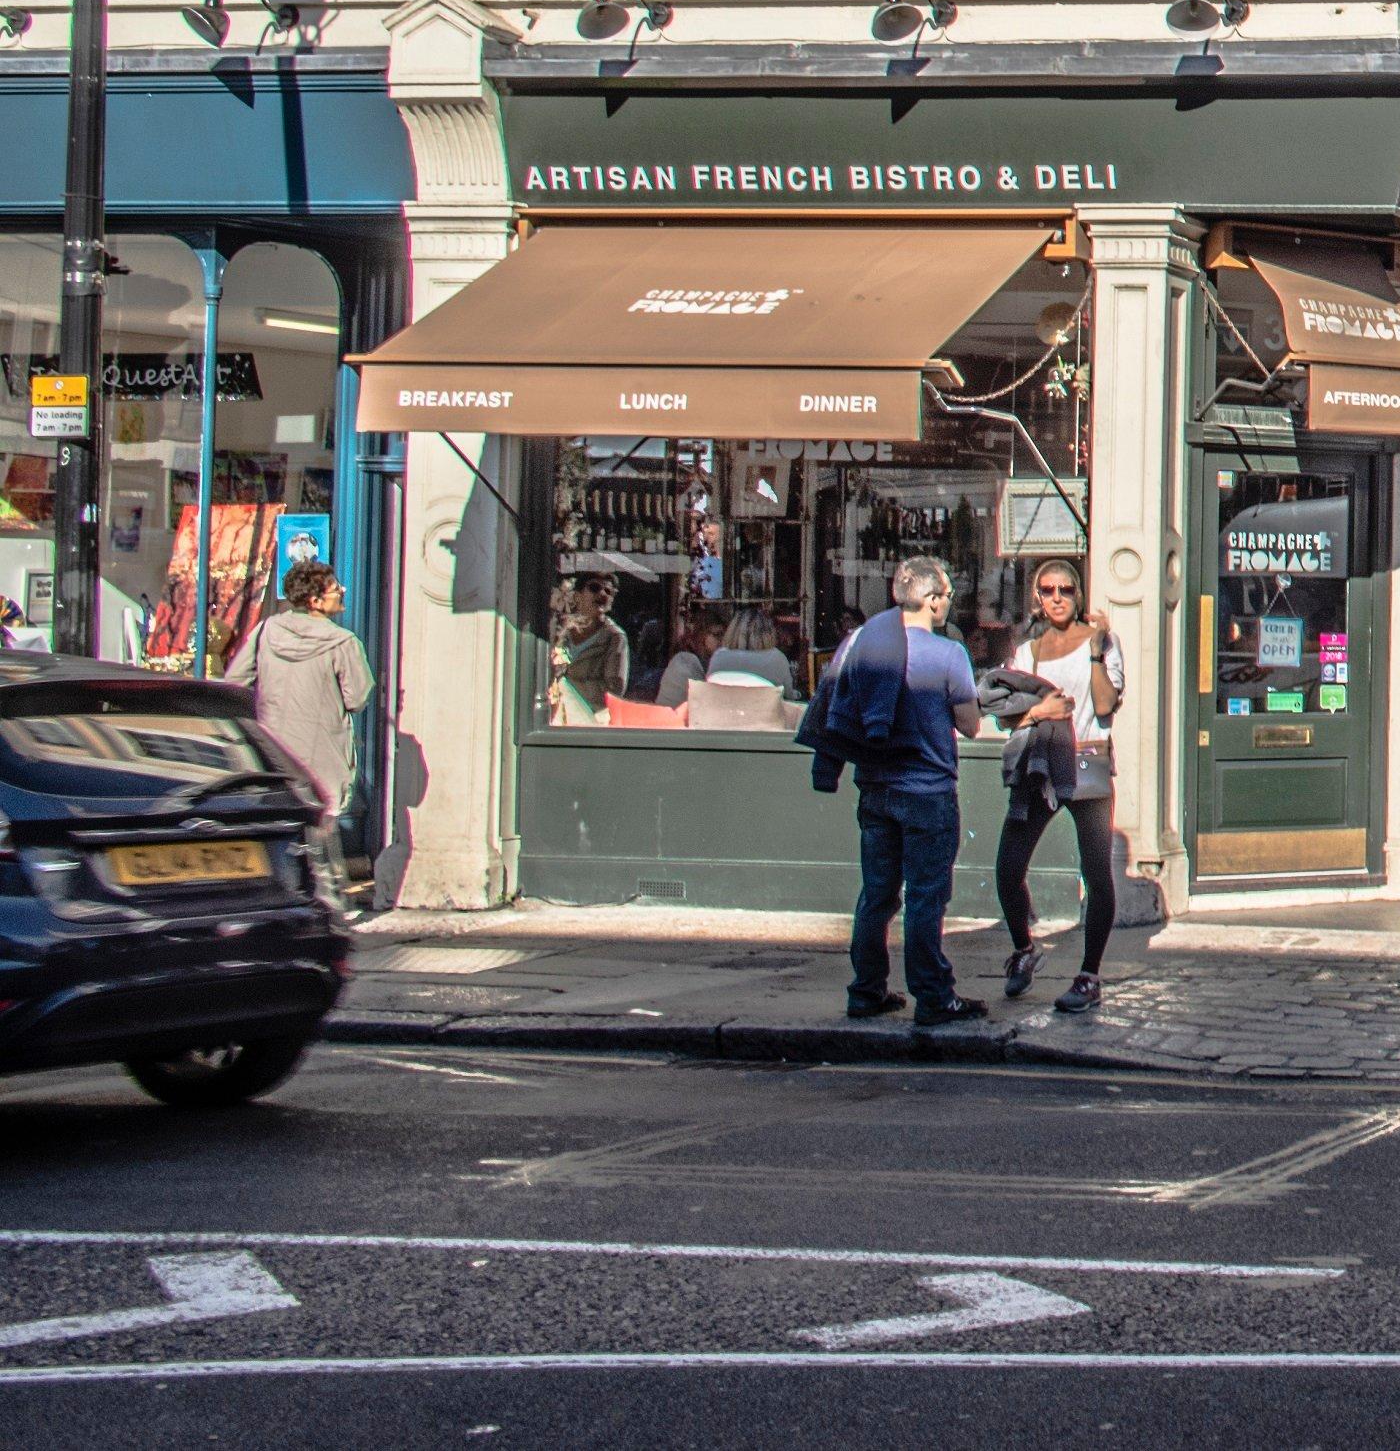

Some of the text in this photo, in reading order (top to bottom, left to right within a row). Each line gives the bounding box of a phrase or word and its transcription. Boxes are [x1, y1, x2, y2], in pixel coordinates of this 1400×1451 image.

[525, 163, 1117, 191] ARTISAN FRENCH BISTRO & DELI
[628, 299, 780, 314] FROMAGE
[1299, 298, 1384, 321] CHAMPAGNE
[102, 364, 231, 387] QuestAt
[398, 389, 878, 414] BREAKFAST LUNCH DINNER
[36, 411, 83, 420] No loading
[748, 439, 893, 461] FROMAGE
[1228, 531, 1315, 550] CHAMPAGNE
[1228, 550, 1331, 572] FROMAGE
[1262, 644, 1295, 656] OPEN
